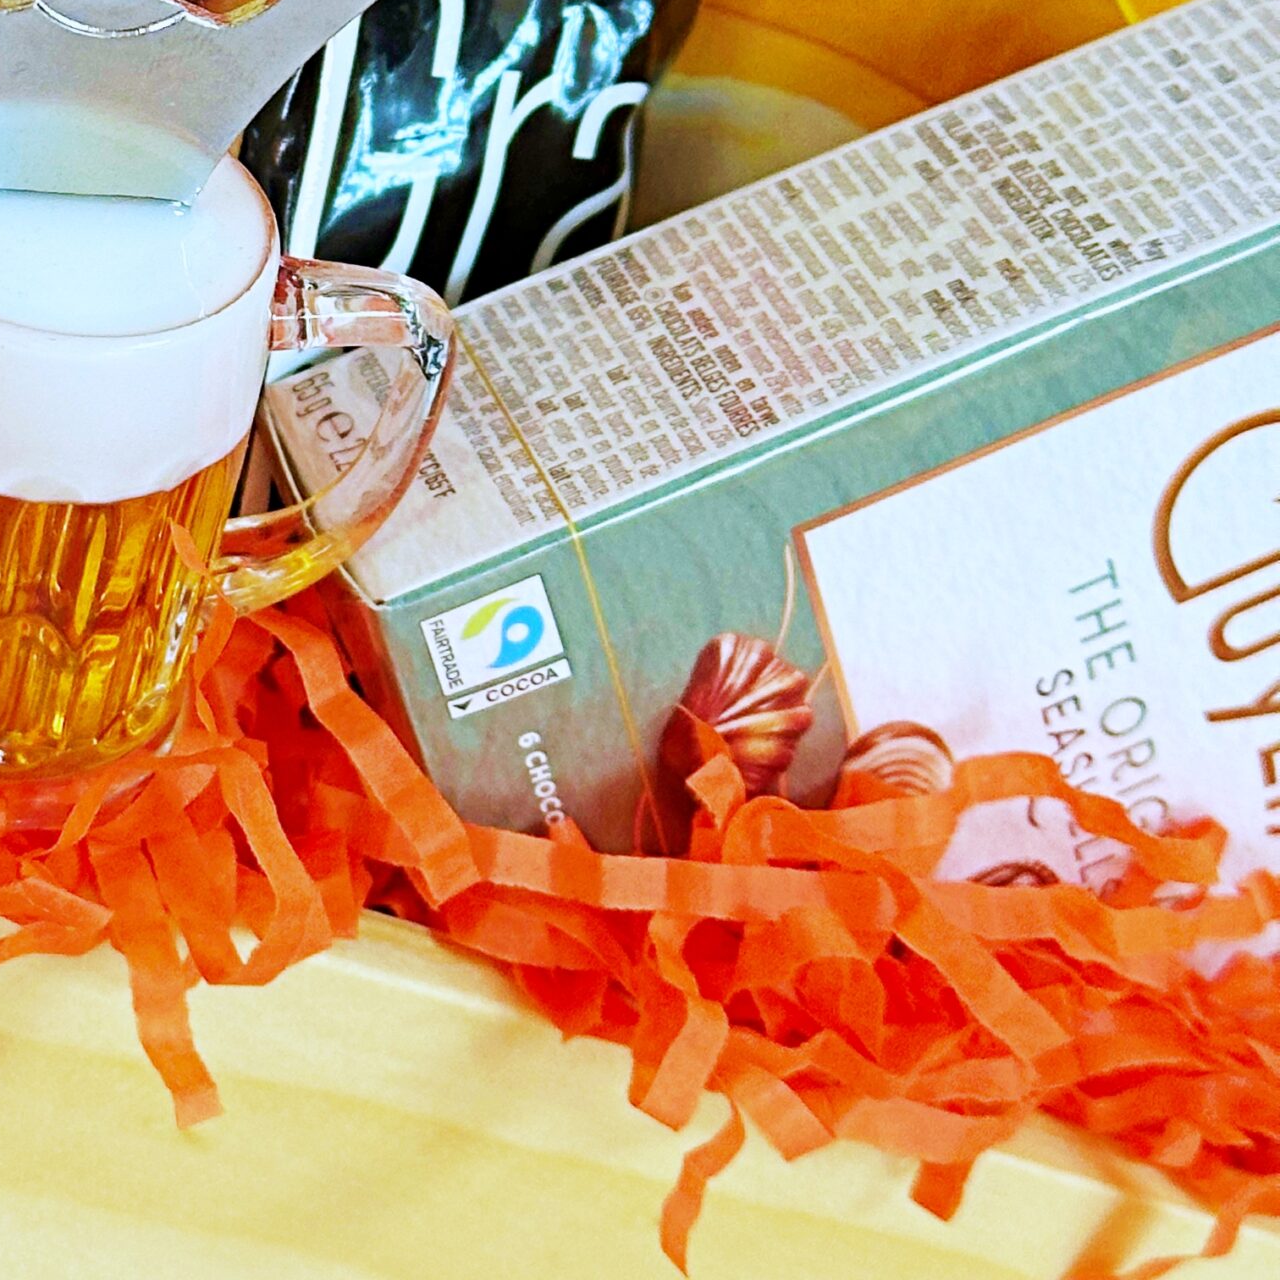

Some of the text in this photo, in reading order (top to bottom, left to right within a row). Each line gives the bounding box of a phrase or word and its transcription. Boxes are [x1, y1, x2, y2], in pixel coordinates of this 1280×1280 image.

[1047, 206, 1125, 283] CHOCOLAATJES
[650, 299, 707, 358] CHOCOLATS
[687, 353, 732, 394] BELGES
[712, 387, 767, 439] FOURRÉS
[684, 305, 723, 341] andere
[711, 342, 746, 374] noten
[734, 376, 758, 393] en
[747, 394, 785, 428] tarwe
[428, 620, 464, 689] FAIRTRADE
[485, 667, 560, 703] COCOA
[1068, 558, 1169, 835] THE ORIG
[518, 731, 565, 825] 6 CHOCO
